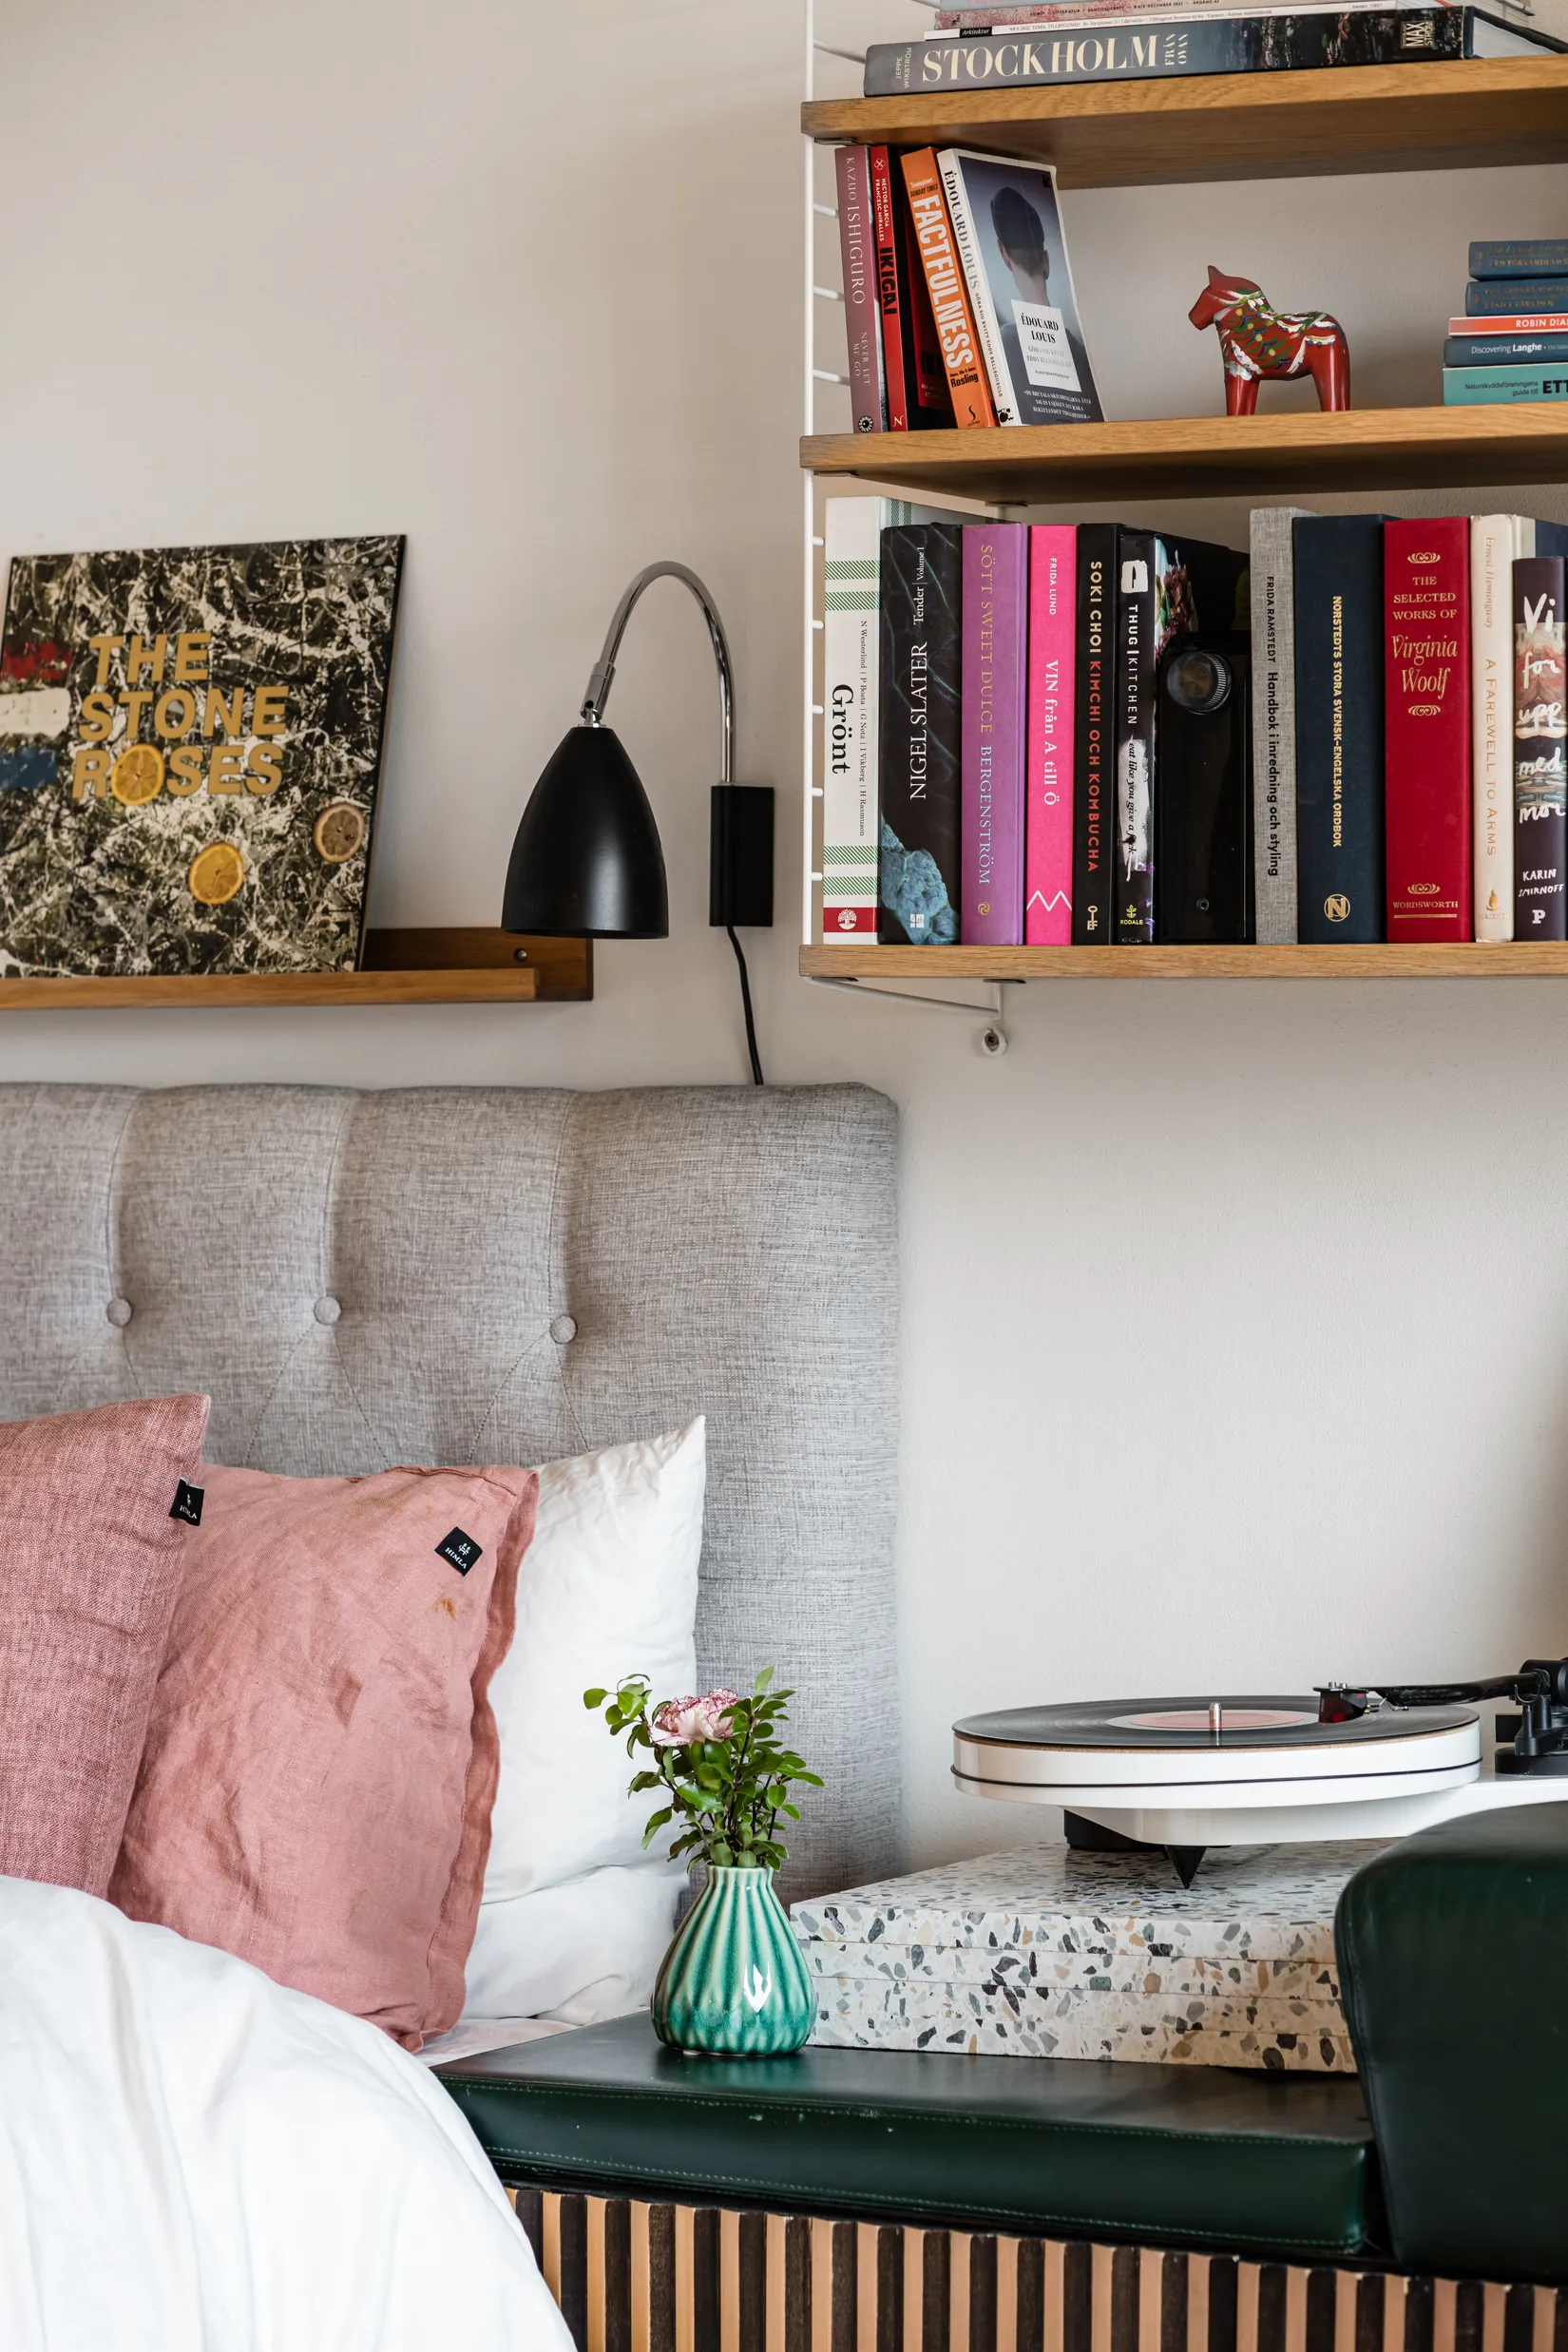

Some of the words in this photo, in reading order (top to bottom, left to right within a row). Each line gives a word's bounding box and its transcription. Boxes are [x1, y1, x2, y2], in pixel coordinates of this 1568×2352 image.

[1406, 23, 1425, 47] MAX
[922, 33, 1161, 84] STOCKHOLM
[846, 157, 857, 201] KAZUO
[910, 187, 926, 198] SUNDAY
[944, 170, 968, 242] ÉDOUARD
[962, 245, 980, 289] LOUIS
[847, 206, 866, 304] ISHIGURO
[879, 247, 897, 316] IKIGAI
[912, 194, 973, 369] FACTFULNESS
[1021, 312, 1059, 332] ÉDOUARD
[1031, 331, 1056, 344] LOUIS
[1471, 345, 1511, 354] Discovering
[1513, 342, 1542, 354] Langhe
[854, 361, 861, 376] GO
[950, 373, 979, 388] Rosling
[1465, 380, 1539, 390] Naturskyddsföreningens
[981, 545, 996, 595] SÖTT
[1484, 536, 1496, 569] Ernest
[1090, 561, 1102, 602] SOKI
[1266, 576, 1274, 606] FRIDA
[1393, 593, 1457, 603] SELECTED
[1412, 576, 1437, 585] THE
[913, 586, 924, 625] Tender
[1392, 610, 1437, 621] WORKS
[1440, 609, 1458, 620] OF
[1484, 571, 1496, 630] Hemingway
[1523, 593, 1557, 634] Vi
[981, 602, 993, 663] SWEET
[1089, 609, 1102, 653] CHOI
[1128, 604, 1138, 645] THUG
[1267, 608, 1275, 663] RAMSTEDT
[1333, 596, 1343, 659] NORSTEDTS
[88, 632, 213, 684] THE
[1391, 635, 1458, 665] Virginia
[1486, 659, 1497, 671] A
[910, 641, 927, 726] SLATER
[1045, 660, 1059, 692] VIN
[1333, 661, 1343, 698] STORA
[1401, 667, 1451, 699] Woolf
[1522, 652, 1561, 690] for
[981, 671, 993, 734] DULCE
[1089, 660, 1101, 722] KIMCHI
[1127, 658, 1138, 724] KITCHEN
[1268, 671, 1279, 732] Handbok
[78, 685, 289, 743] STONE
[832, 684, 854, 774] Grönt
[1044, 698, 1058, 735] från
[1486, 679, 1497, 772] FAREWELL
[1519, 701, 1562, 730] upp
[910, 730, 927, 800] NIGEL
[1043, 741, 1058, 755] A
[1088, 729, 1100, 766] OCH
[1128, 742, 1137, 758] eat
[1333, 699, 1343, 801] SVENSK-ENGELSKA
[1520, 746, 1563, 775] med
[72, 743, 285, 806] ROSES
[1043, 760, 1058, 785] till
[1128, 760, 1137, 779] like
[1267, 742, 1280, 804] inredning
[1043, 792, 1061, 806] Ö
[1126, 779, 1135, 799] you
[1486, 779, 1497, 800] TO
[979, 745, 994, 885] BERGENSTRÖM
[1087, 774, 1100, 871] KOMBUCHA
[1125, 800, 1137, 822] give
[1269, 806, 1281, 831] och
[1332, 802, 1342, 848] ORDBOK
[1519, 802, 1566, 824] mor
[1126, 832, 1137, 855] fck
[1486, 808, 1498, 856] ARMS
[1268, 833, 1281, 877] styling
[1519, 883, 1565, 898] SMIRNOFF
[1522, 869, 1557, 882] KARIN
[1393, 901, 1459, 909] WORDSWORTH
[1532, 909, 1546, 924] P
[445, 1547, 468, 1570] HIMLA
